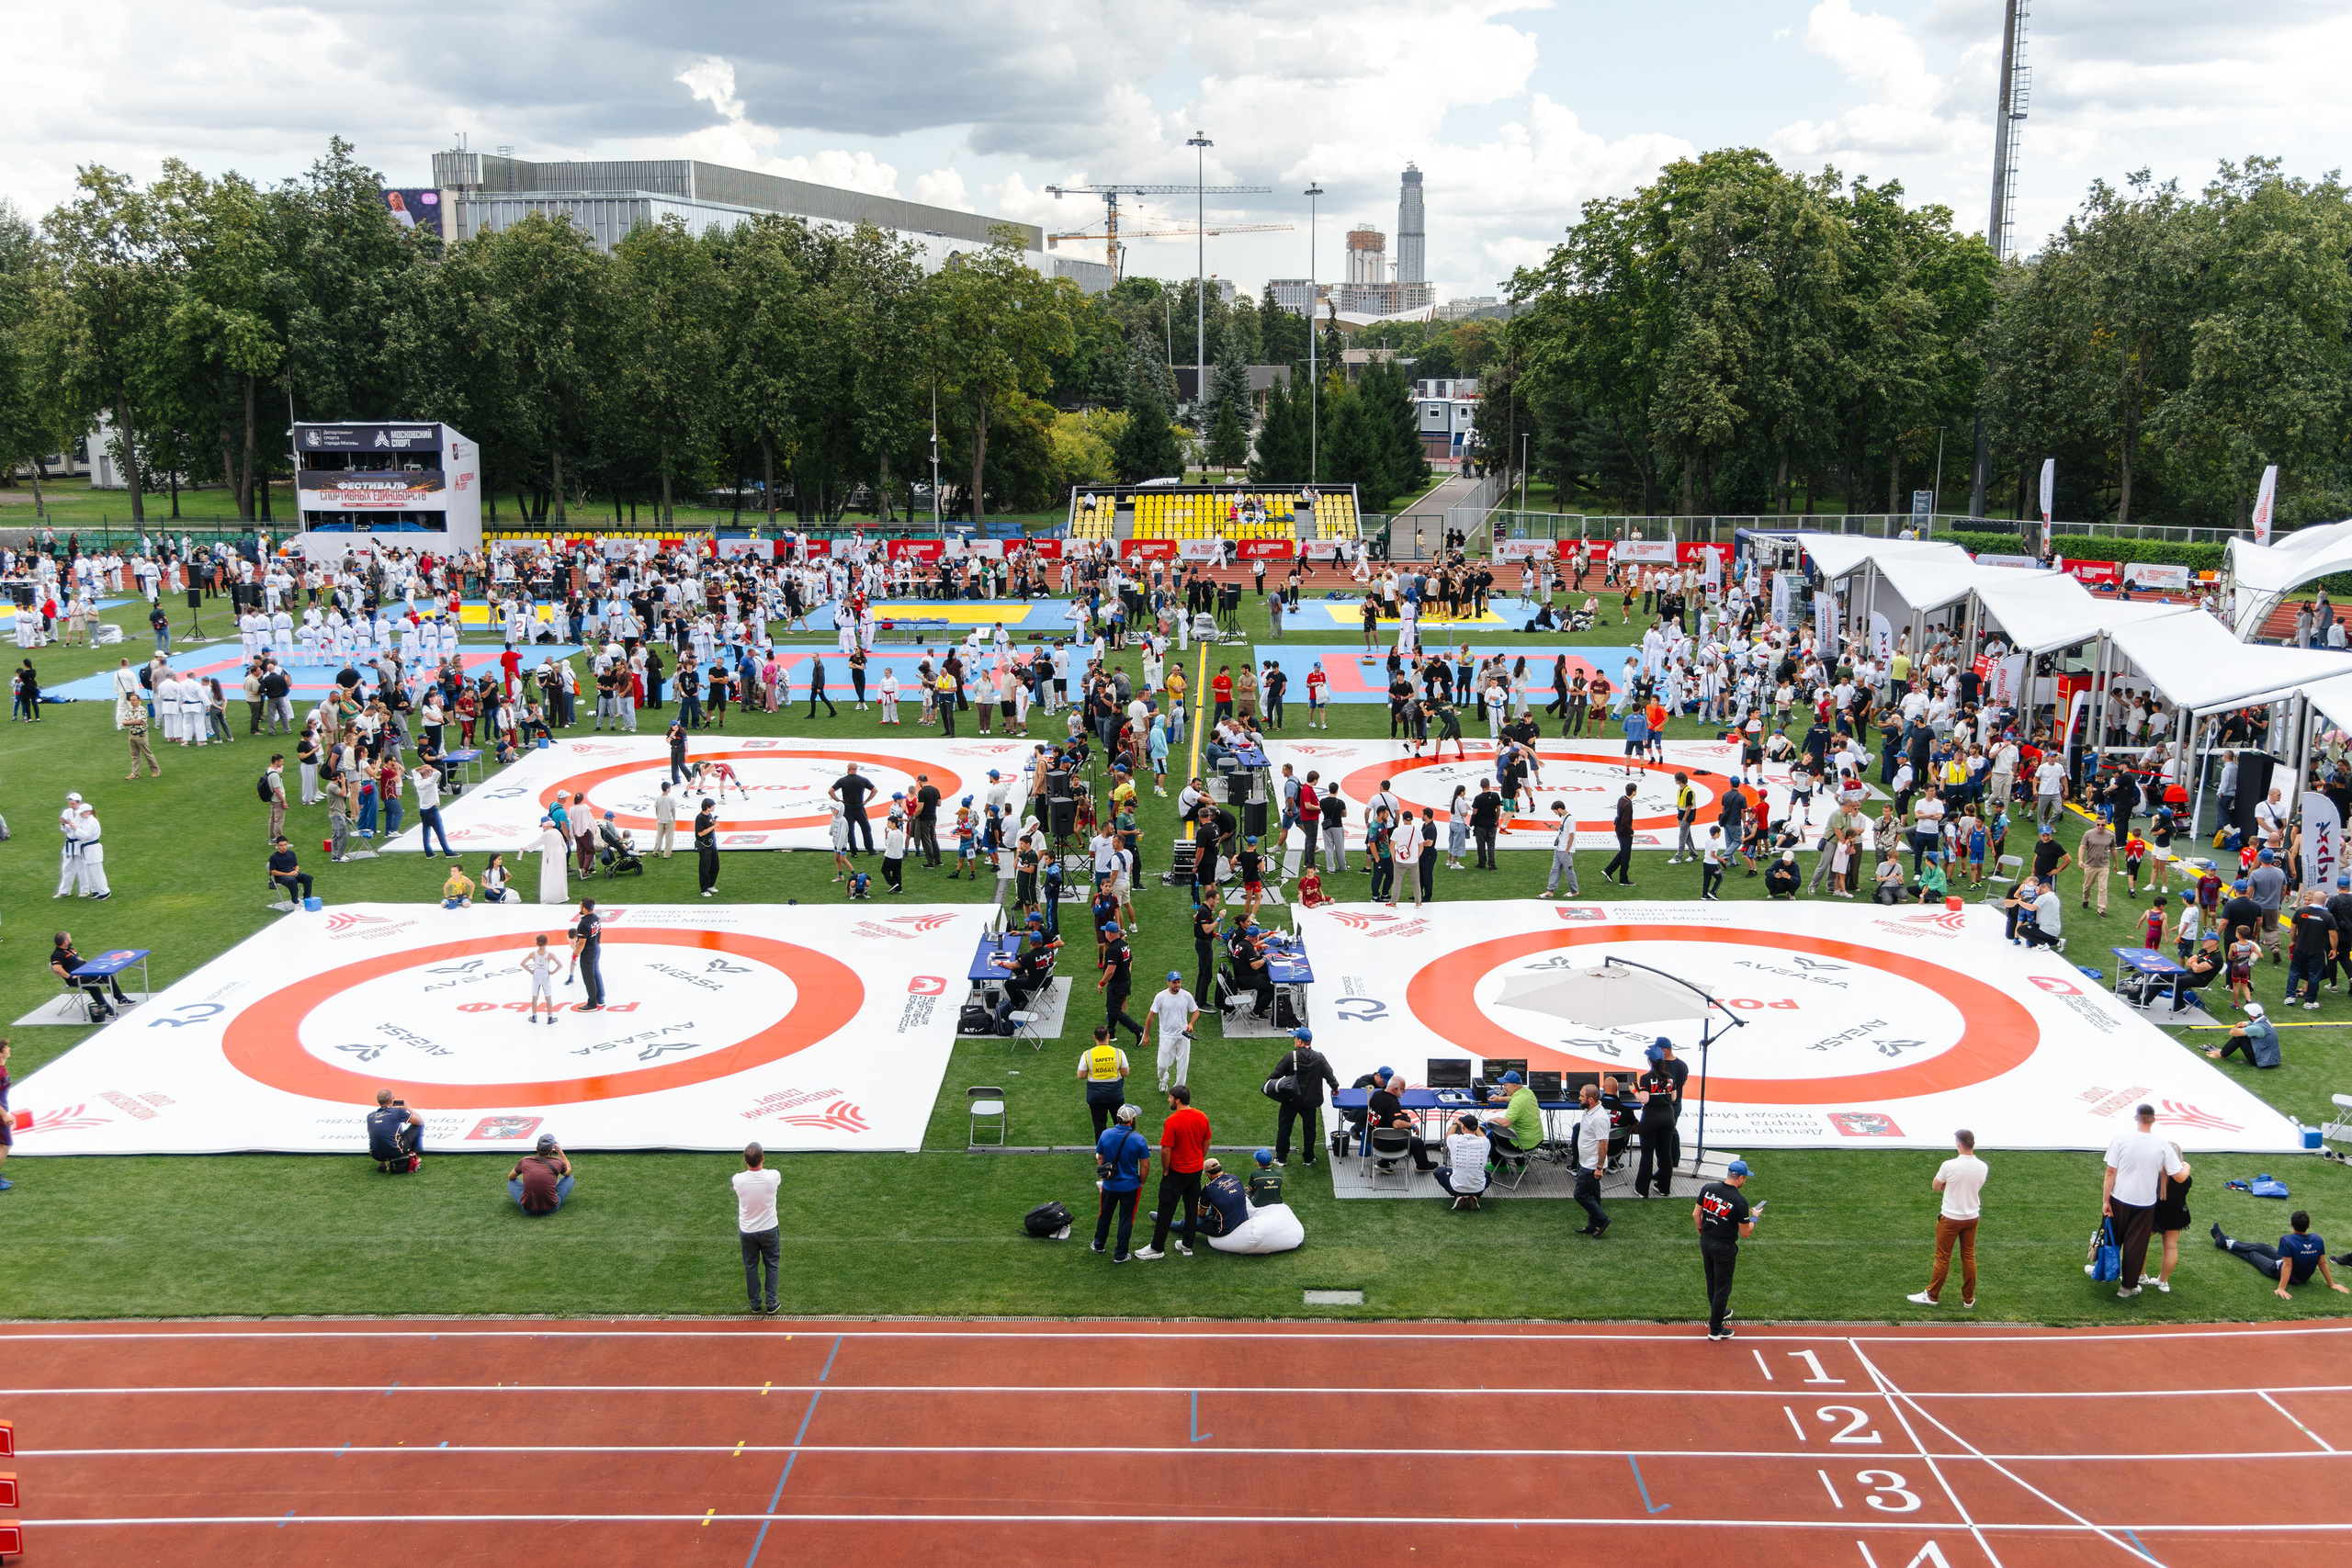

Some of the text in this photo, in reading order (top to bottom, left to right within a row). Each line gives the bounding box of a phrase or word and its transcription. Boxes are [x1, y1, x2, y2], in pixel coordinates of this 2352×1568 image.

[390, 429, 433, 439] МОСКОВСКИЙ
[390, 439, 411, 447] СПОРТ
[320, 490, 427, 502] СПОРТИВНЫХ ЕДИНОБОРСТВ
[1996, 668, 2007, 707] МОСКОВСКИЙ
[329, 919, 419, 942] МОСКОВСКИЙ
[361, 927, 404, 940] СПОРТ
[851, 929, 888, 939] СПОРТ
[854, 920, 920, 940] МОСКОВСКИЙ
[1365, 919, 1430, 938] МОСКОВСКИЙ
[1396, 926, 1430, 938] СПОРТ
[1871, 919, 1958, 940] МОСКОВСКИЙ
[1882, 927, 1928, 938] СПОРТ
[645, 963, 725, 991] AVEASA
[1734, 960, 1849, 988] AVEASA
[897, 994, 918, 1033] БОРЬБЫ РОССИИ
[910, 995, 927, 1028] СПОРТИВНОЙ
[921, 996, 937, 1025] ФЕДЕРАЦИЯ
[375, 1022, 454, 1056] AVEASA
[569, 1021, 695, 1055] AVEASA
[1805, 1019, 1887, 1053] AVEASA
[740, 1089, 843, 1120] МОСКОВСКИЙ
[753, 1089, 803, 1106] СПОРТ
[1745, 1111, 1813, 1120] города
[1787, 1349, 1846, 1382] 1
[1816, 1405, 1883, 1443] 2
[1856, 1470, 1921, 1512] 3
